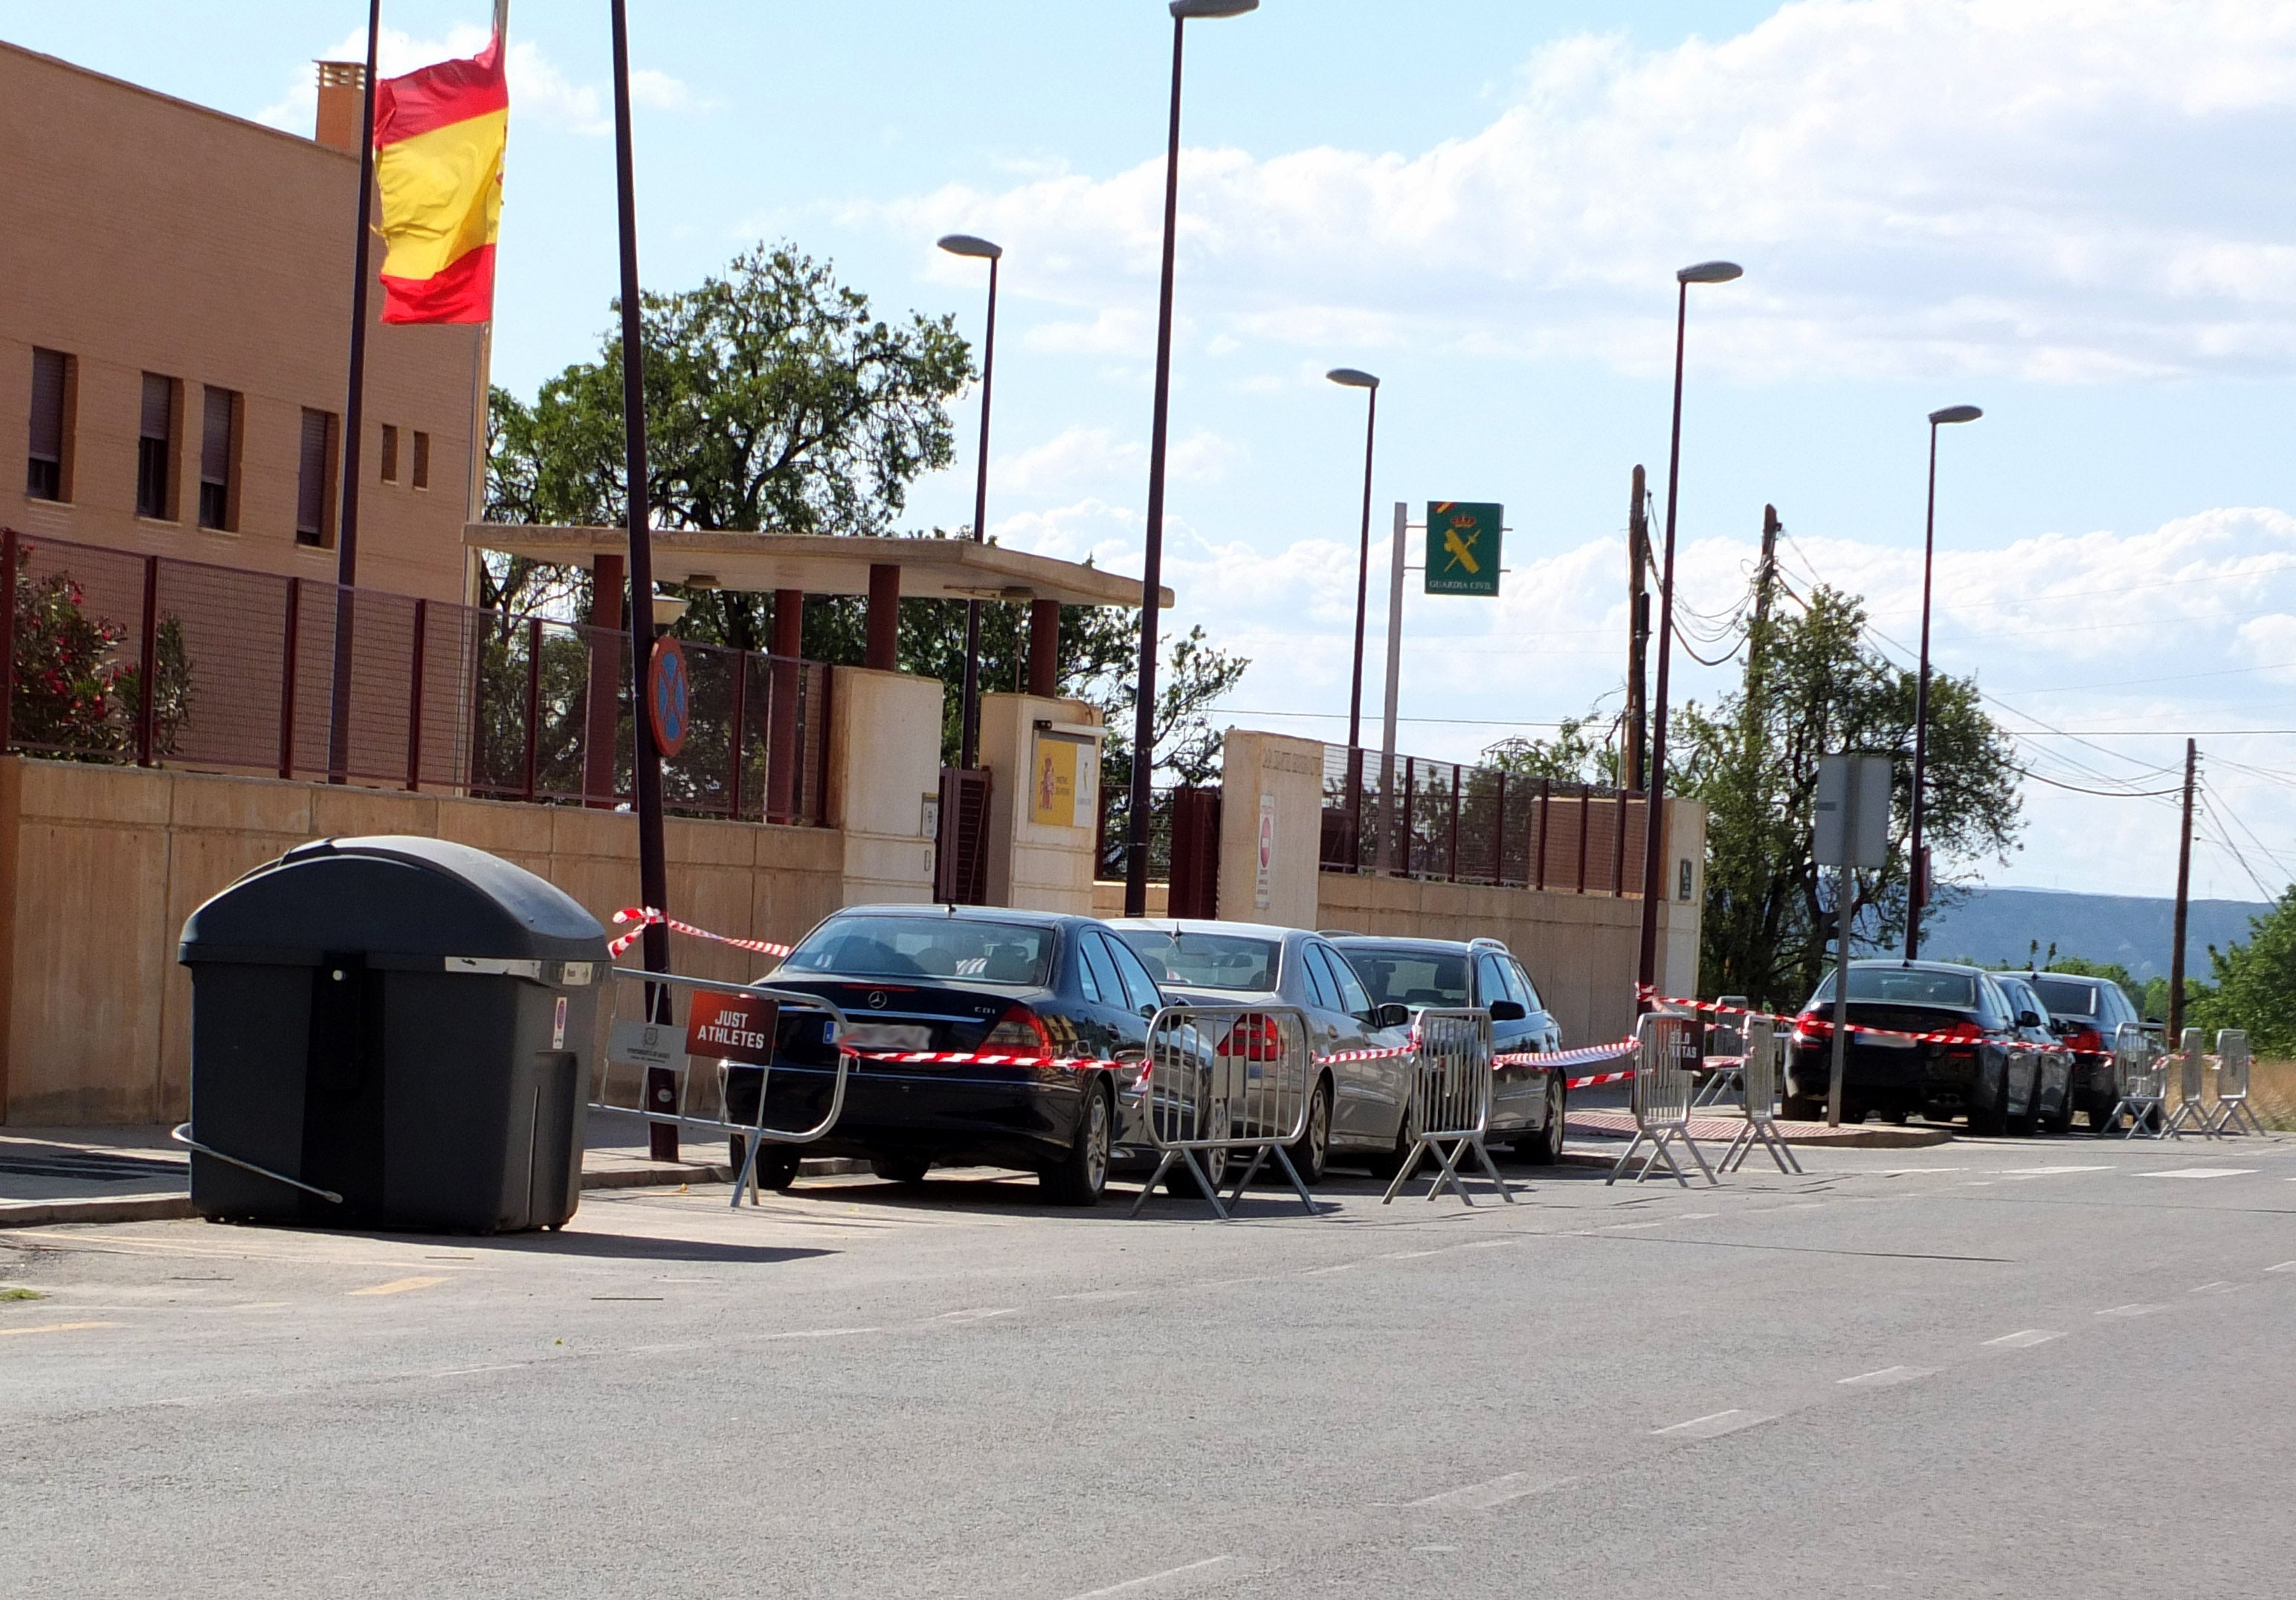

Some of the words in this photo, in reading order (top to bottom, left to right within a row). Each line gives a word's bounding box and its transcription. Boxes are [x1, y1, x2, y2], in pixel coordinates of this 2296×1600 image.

[1429, 580, 1467, 589] GUARDIA
[1469, 581, 1492, 590] CIVIL
[715, 1010, 749, 1028] JUST
[697, 1025, 765, 1049] ATHLETES
